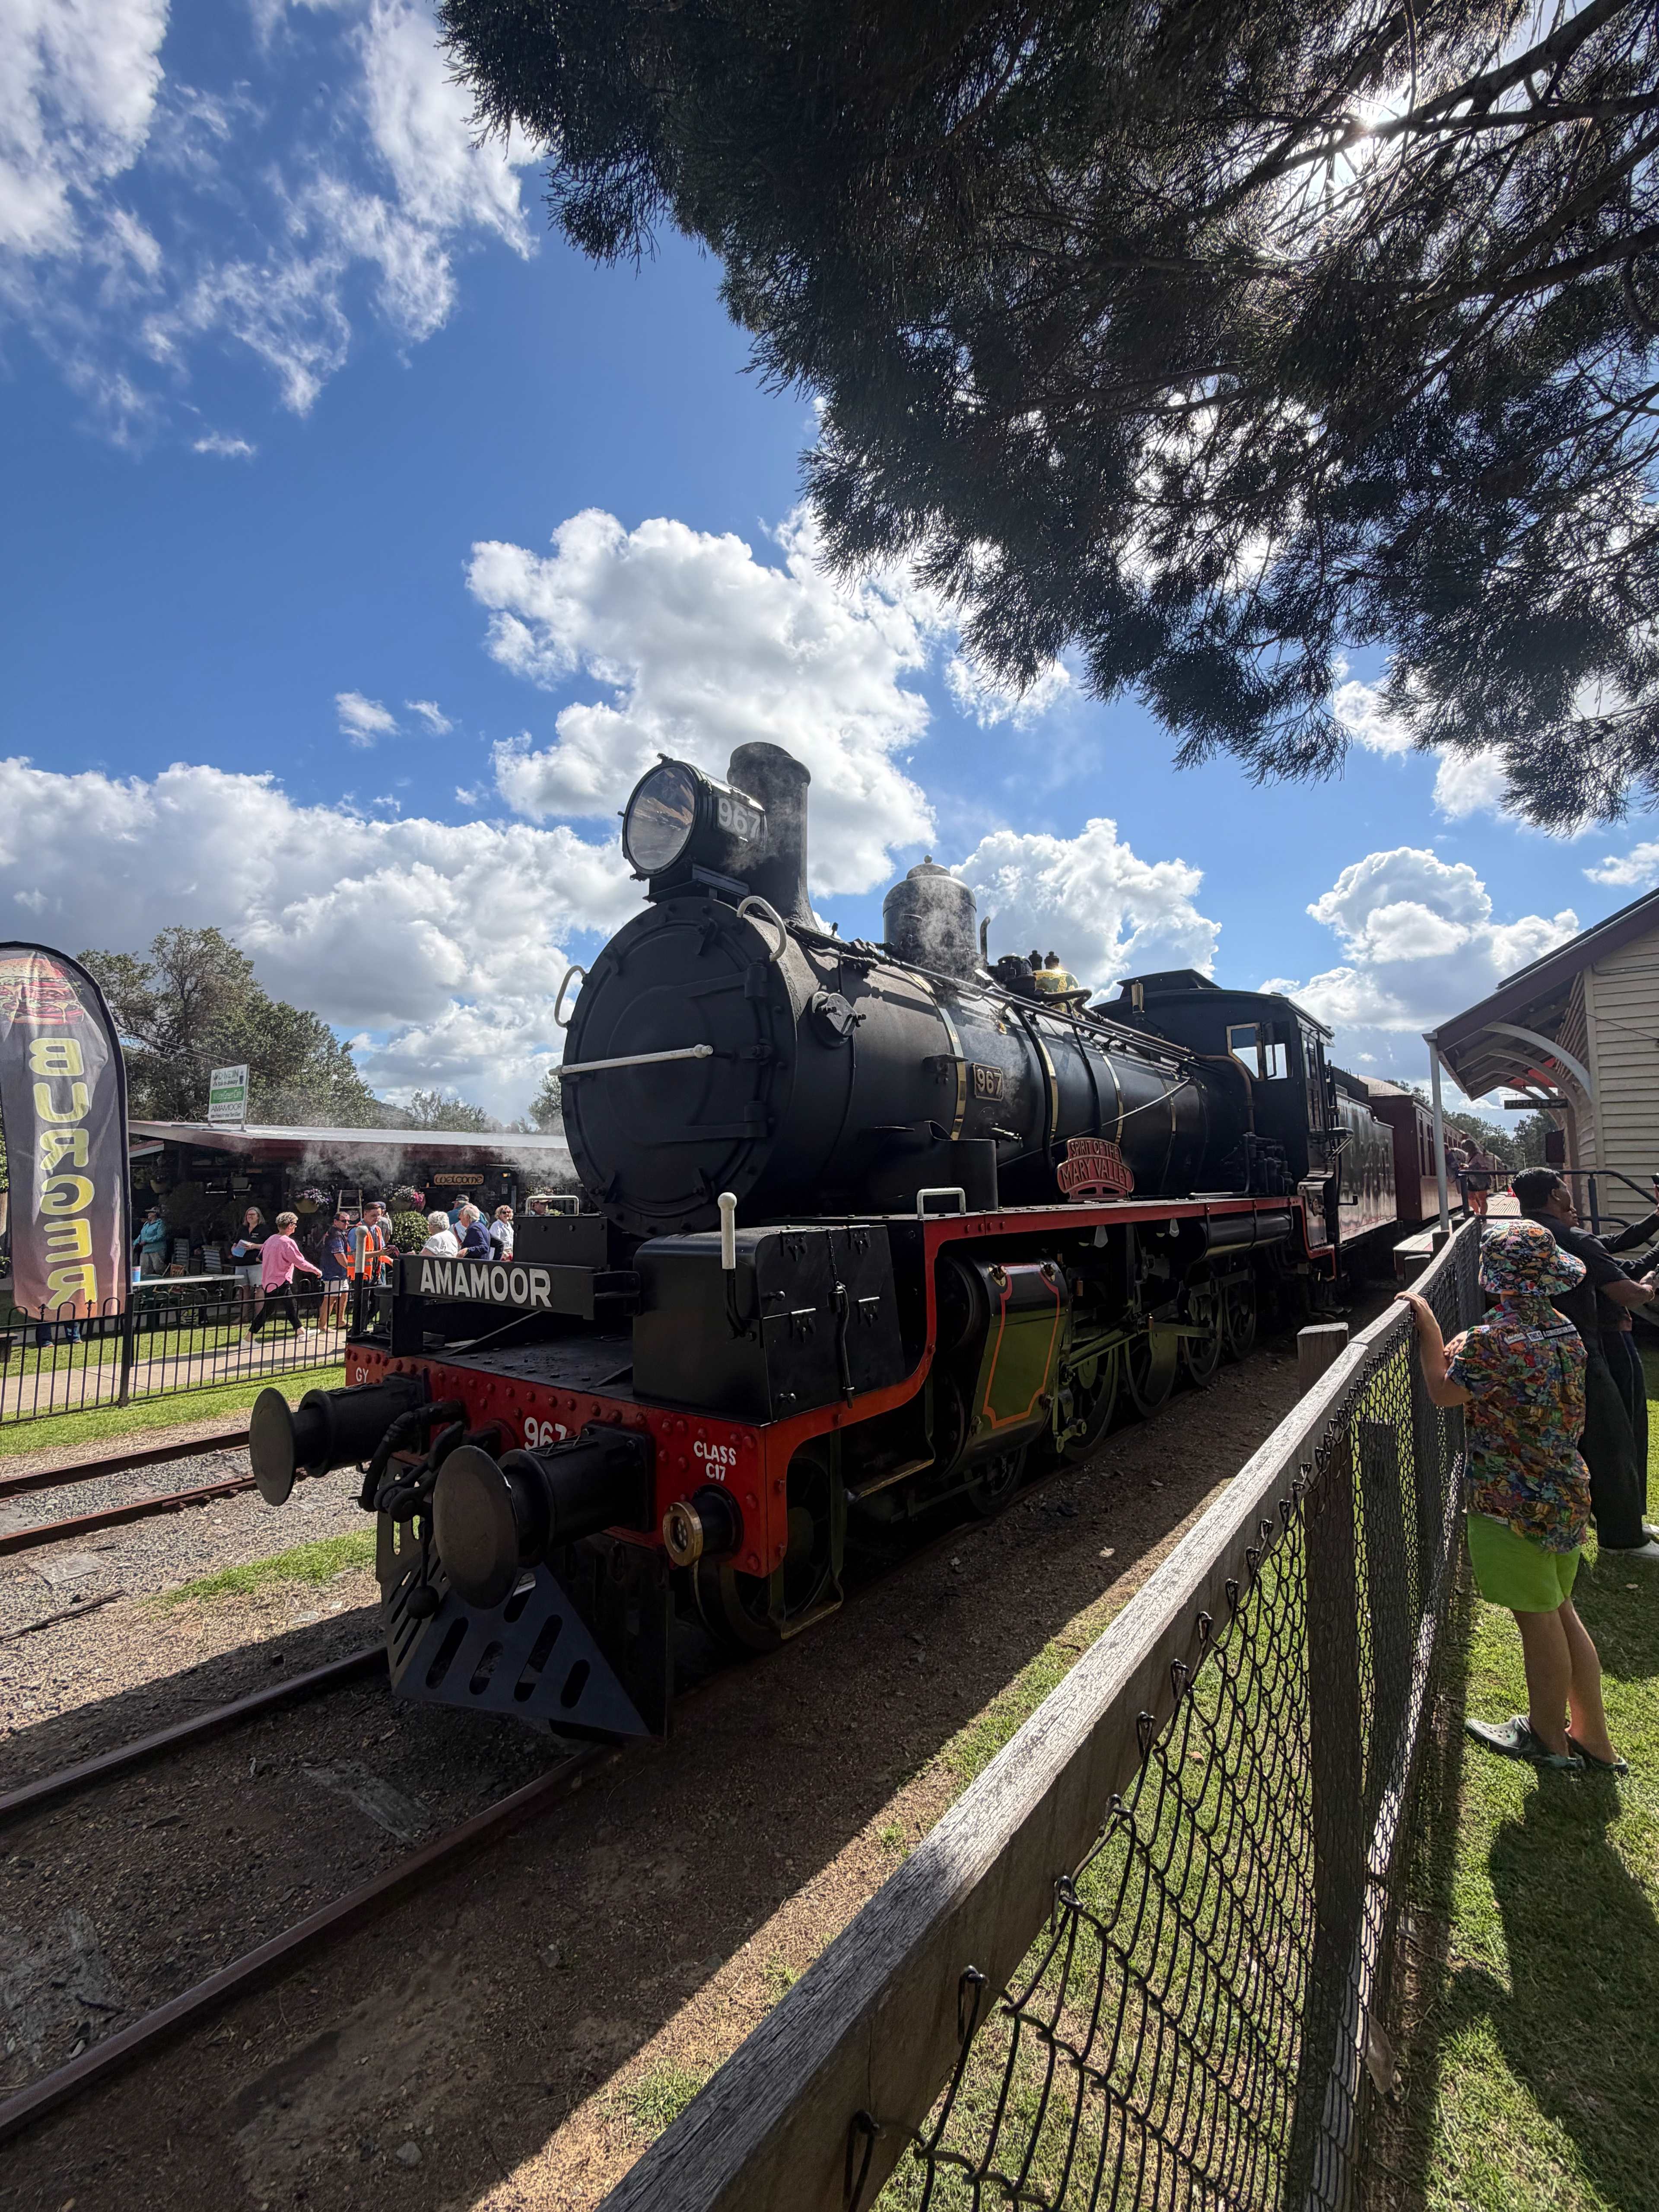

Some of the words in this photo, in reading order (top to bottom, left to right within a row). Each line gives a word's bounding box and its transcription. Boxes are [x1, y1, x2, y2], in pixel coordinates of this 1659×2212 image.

[719, 798, 760, 838] 967
[976, 1069, 1002, 1095] 967
[211, 1103, 242, 1112] AMAMOOR
[1071, 1141, 1091, 1157] SPIRIT
[1093, 1141, 1102, 1154] OF
[1104, 1143, 1121, 1161] THE
[1062, 1158, 1091, 1189] MARY
[1094, 1158, 1130, 1187] VALLEY
[420, 1259, 552, 1307] AMAMOOR
[356, 1367, 369, 1383] GY
[524, 1417, 567, 1451] 967
[693, 1441, 736, 1465] CLASS
[706, 1462, 726, 1481] C17
